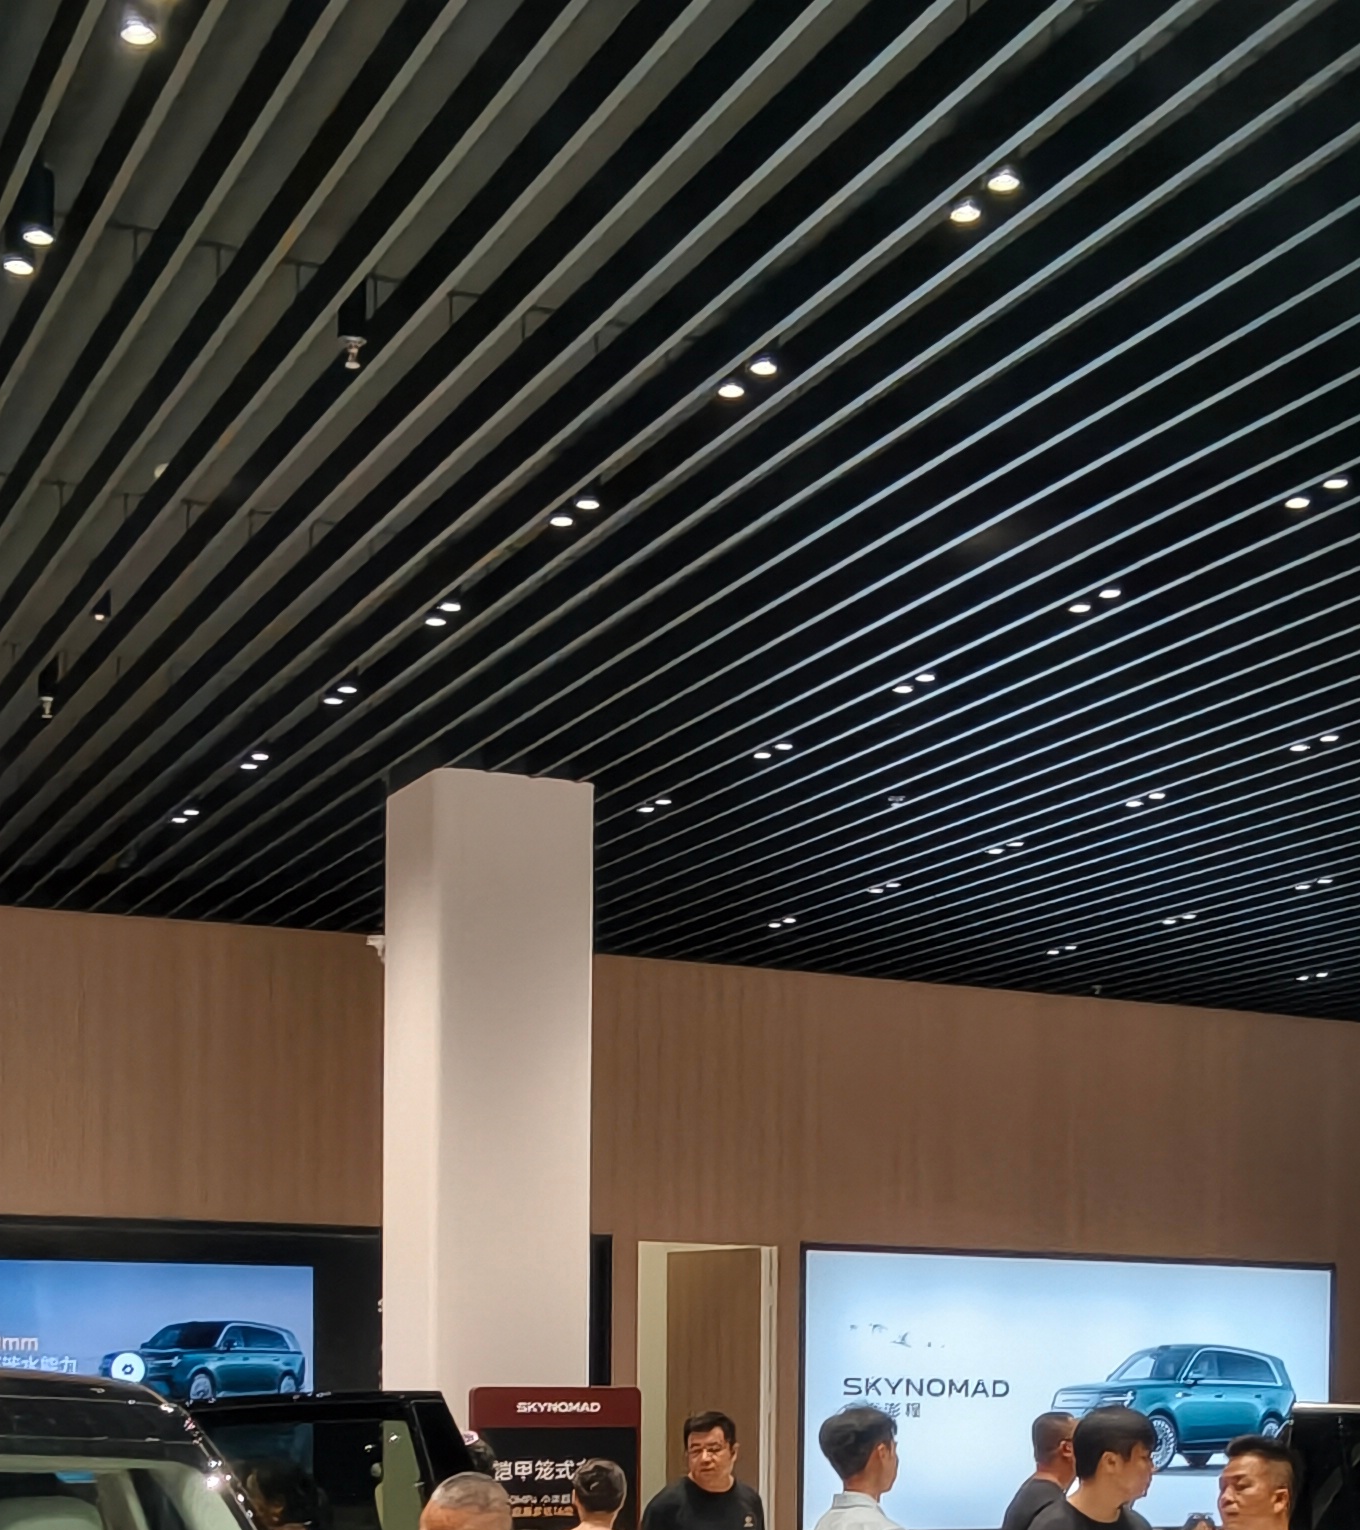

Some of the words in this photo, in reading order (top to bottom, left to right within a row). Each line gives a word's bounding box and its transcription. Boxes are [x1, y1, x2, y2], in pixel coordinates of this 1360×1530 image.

[843, 1377, 1010, 1398] SKYNOMAD
[515, 1401, 601, 1413] SKYNOMAD
[492, 1458, 587, 1482] 铠甲笼式
